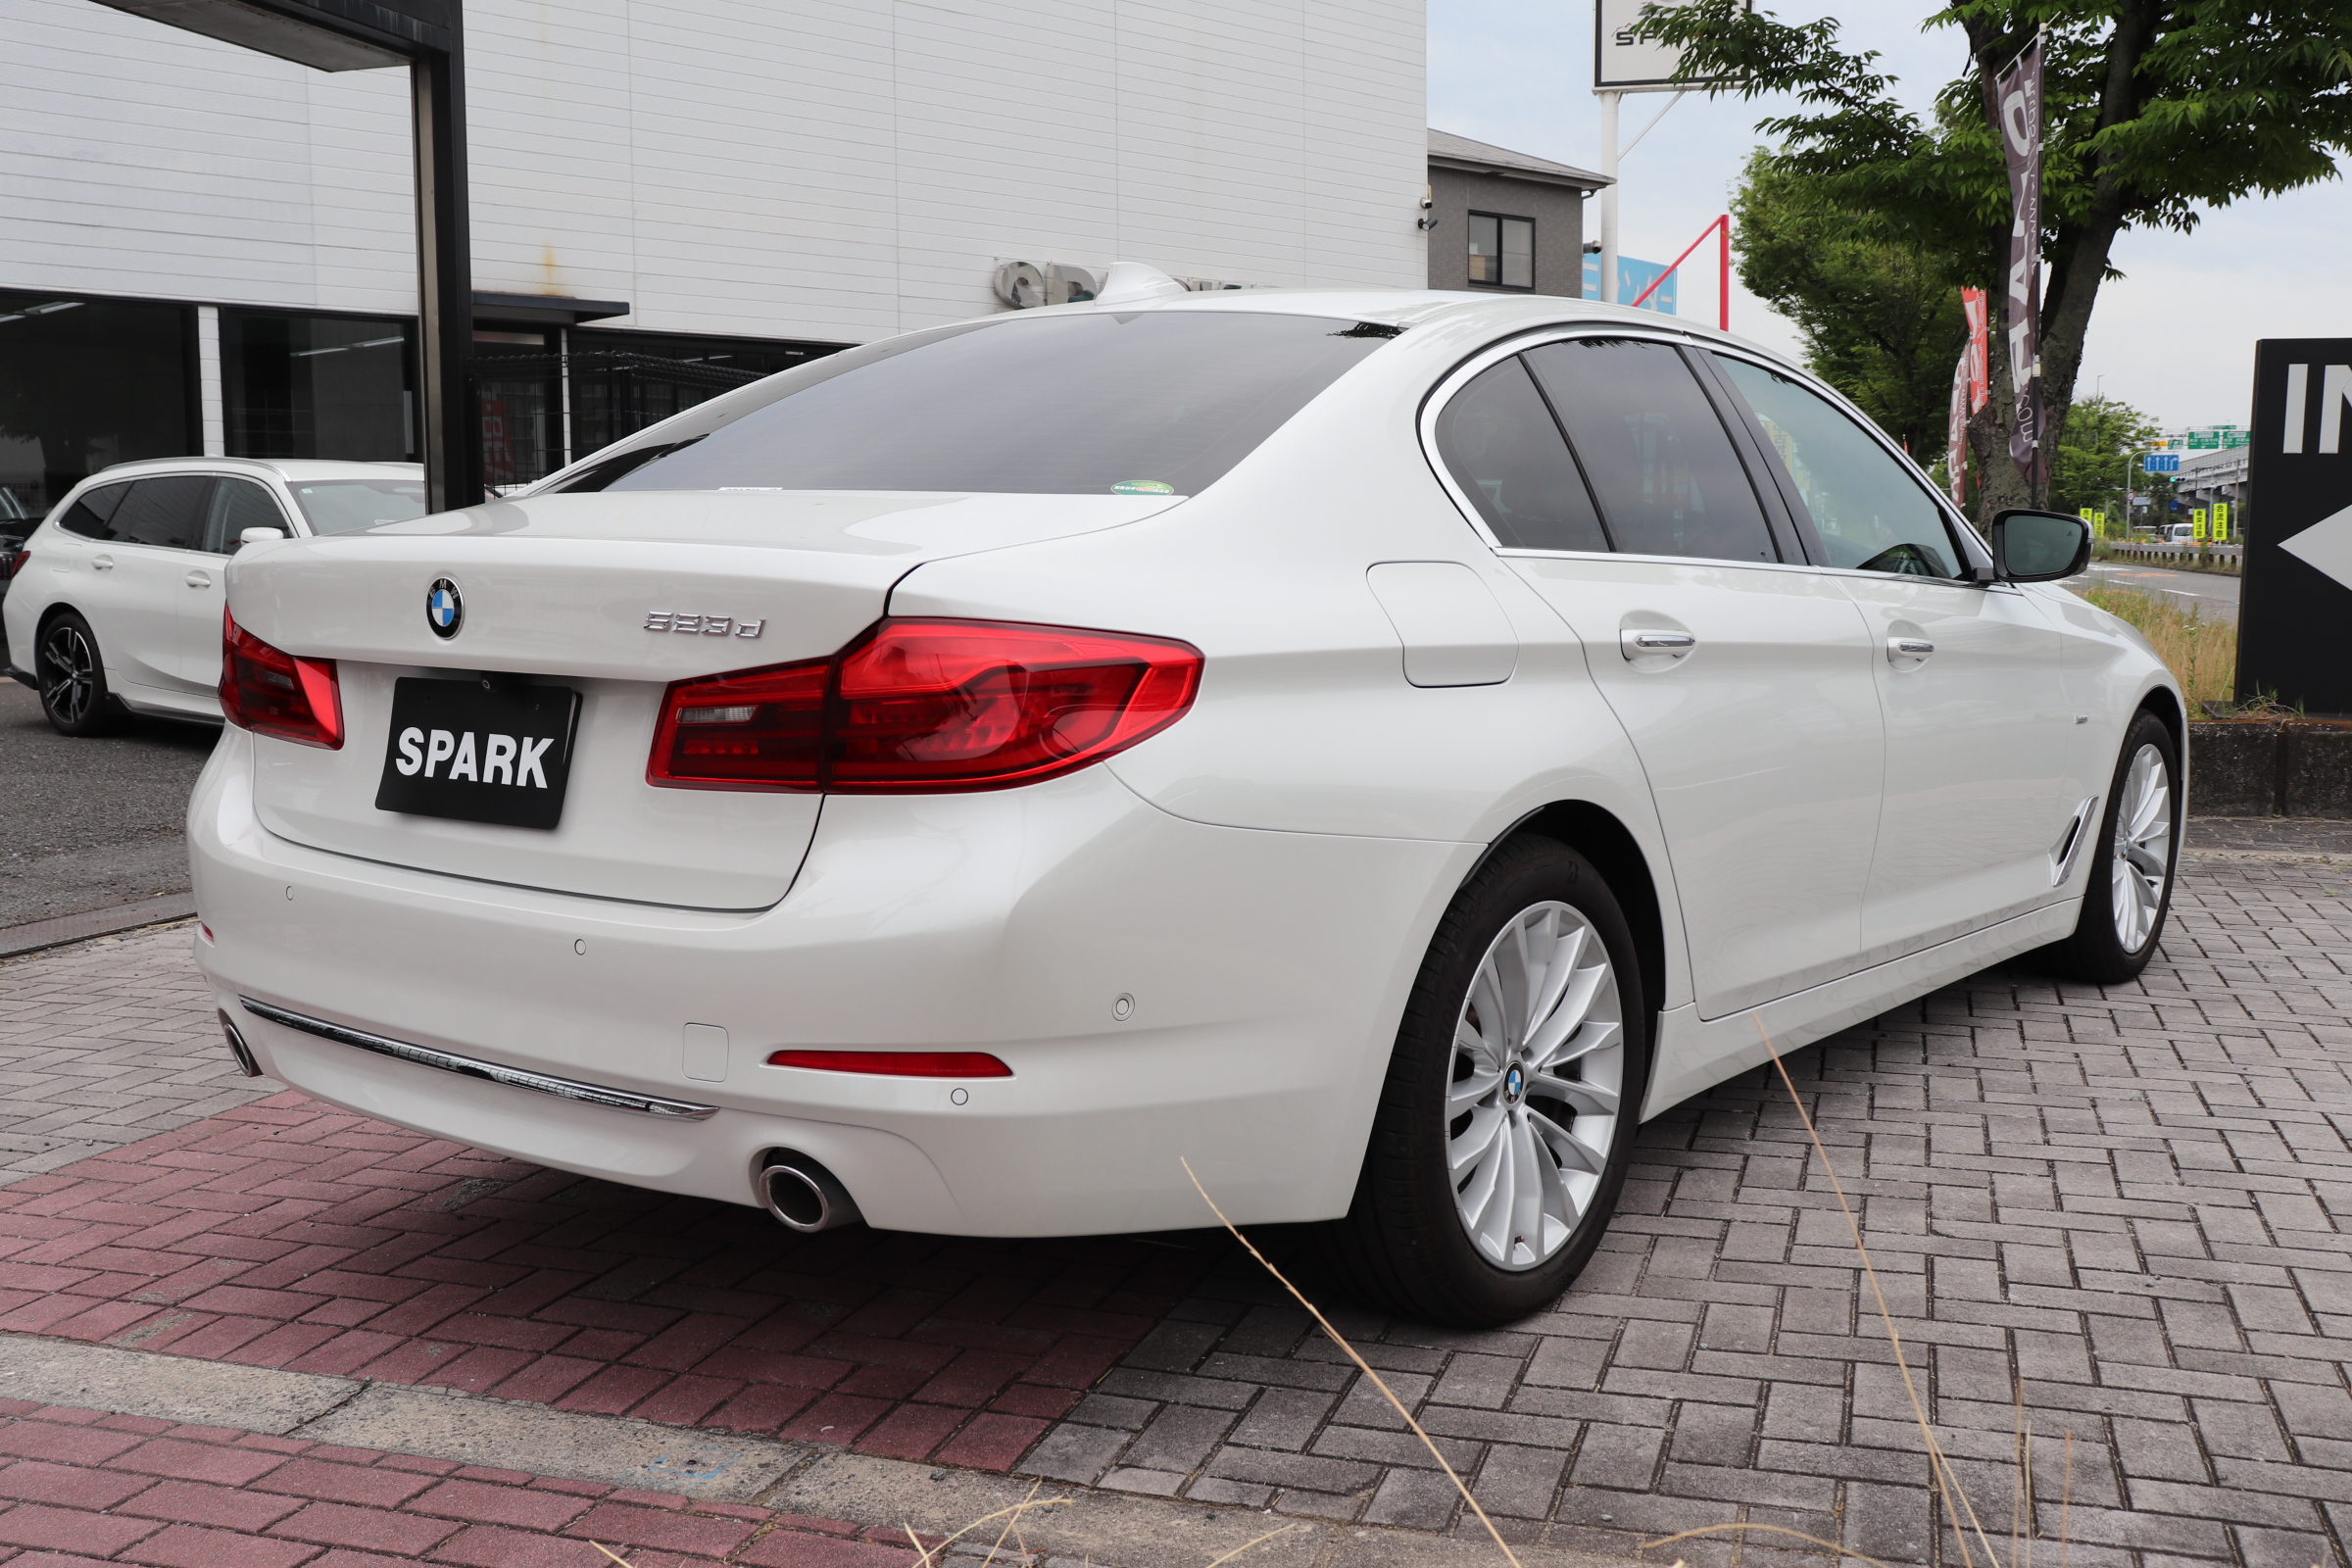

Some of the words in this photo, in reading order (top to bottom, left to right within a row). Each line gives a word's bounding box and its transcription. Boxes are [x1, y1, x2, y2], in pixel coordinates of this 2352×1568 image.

[429, 579, 459, 599] BMW
[644, 611, 766, 638] 523d
[395, 726, 555, 789] SPARK
